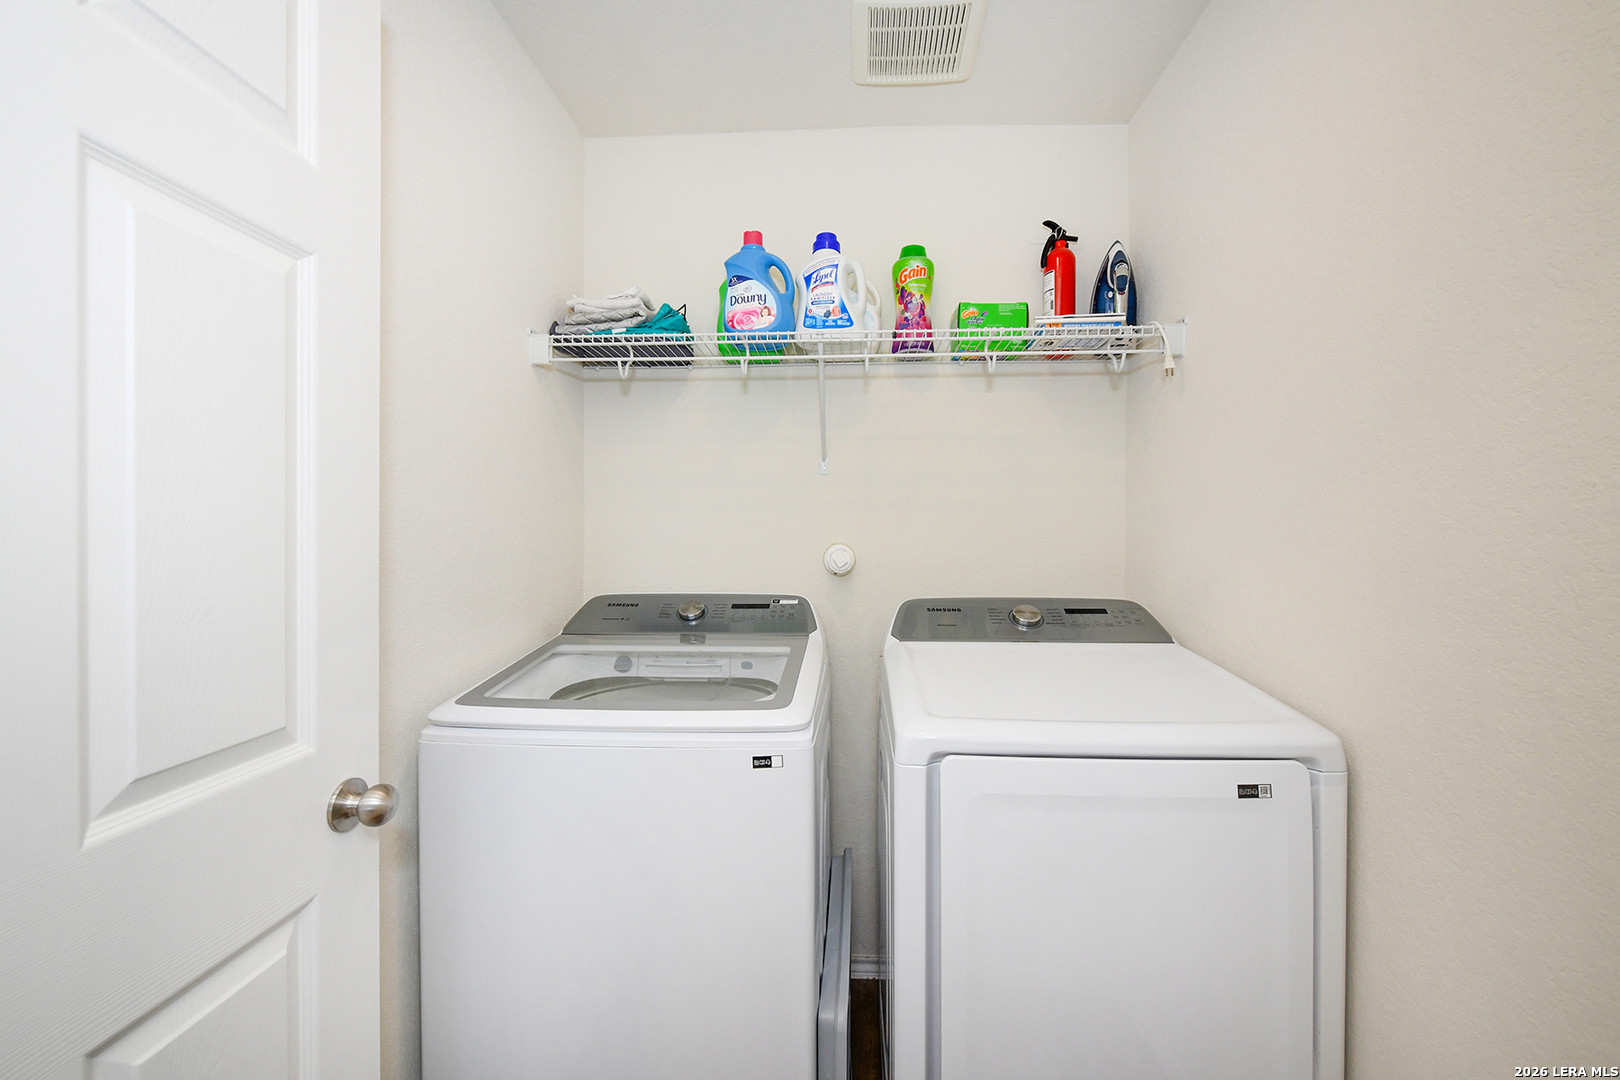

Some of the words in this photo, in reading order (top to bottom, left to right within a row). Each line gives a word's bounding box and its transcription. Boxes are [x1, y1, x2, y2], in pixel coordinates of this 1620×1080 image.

[812, 269, 834, 284] Lysol
[899, 264, 927, 285] Gain
[730, 293, 767, 307] Downy
[961, 309, 979, 319] Gain
